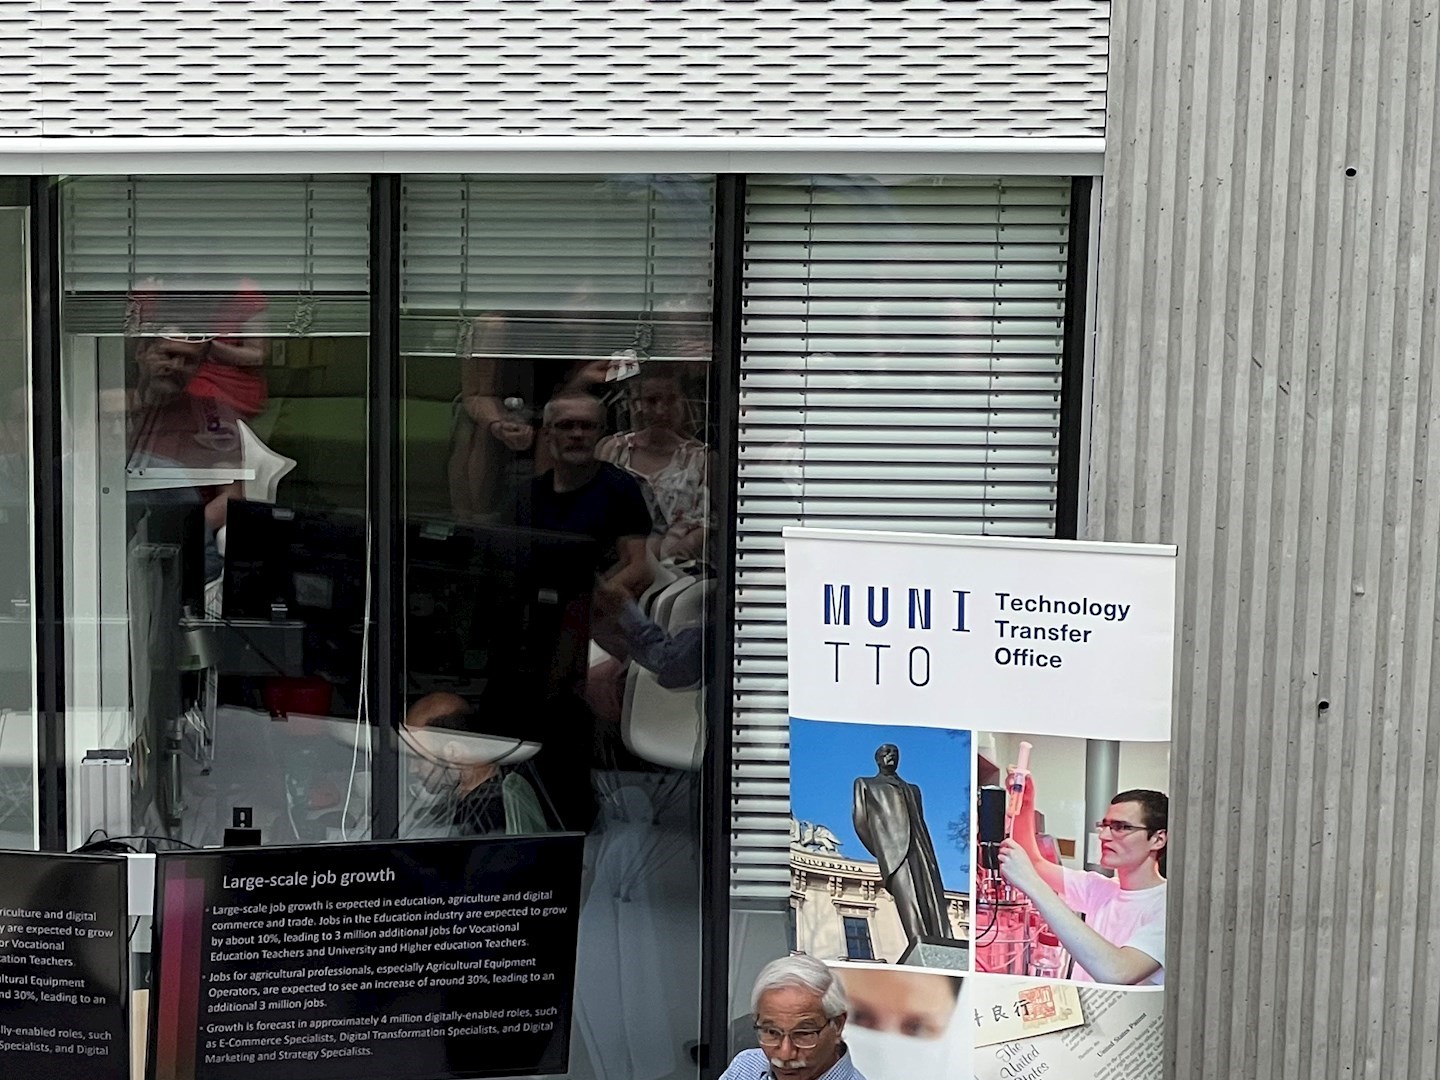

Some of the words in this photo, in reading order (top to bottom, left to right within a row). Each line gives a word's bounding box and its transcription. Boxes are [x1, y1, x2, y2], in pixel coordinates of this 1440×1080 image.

[824, 583, 971, 632] MUNI
[994, 592, 1131, 622] Technology
[994, 620, 1092, 643] Transfer
[824, 641, 930, 688] TTO
[994, 647, 1062, 669] Office
[222, 871, 308, 890] Large-scale
[310, 869, 336, 888] job
[339, 867, 395, 886] growth
[212, 902, 267, 916] Large-scale
[268, 901, 285, 914] job
[287, 900, 323, 913] growth
[325, 900, 333, 909] is
[335, 897, 380, 910] expected
[382, 897, 392, 906] in
[447, 893, 500, 906] agriculture
[501, 891, 521, 901] and
[522, 890, 552, 902] digital
[211, 936, 223, 947] by
[224, 935, 254, 945] about
[283, 931, 319, 943] leading
[321, 931, 332, 940] to
[334, 930, 341, 940] 3
[343, 929, 376, 939] million
[378, 926, 428, 938] additional
[428, 925, 450, 937] jobs
[452, 924, 467, 934] for
[468, 921, 519, 933] Vocational
[30, 975, 84, 987] Equipment
[207, 1000, 257, 1012] additional
[259, 1000, 265, 1010] 3
[267, 999, 301, 1009] million
[88, 1030, 111, 1040] such
[204, 1052, 255, 1063] Marketing
[256, 1050, 276, 1060] and
[278, 1050, 319, 1060] Strategy
[995, 1042, 1021, 1063] The
[1000, 1044, 1040, 1079] United
